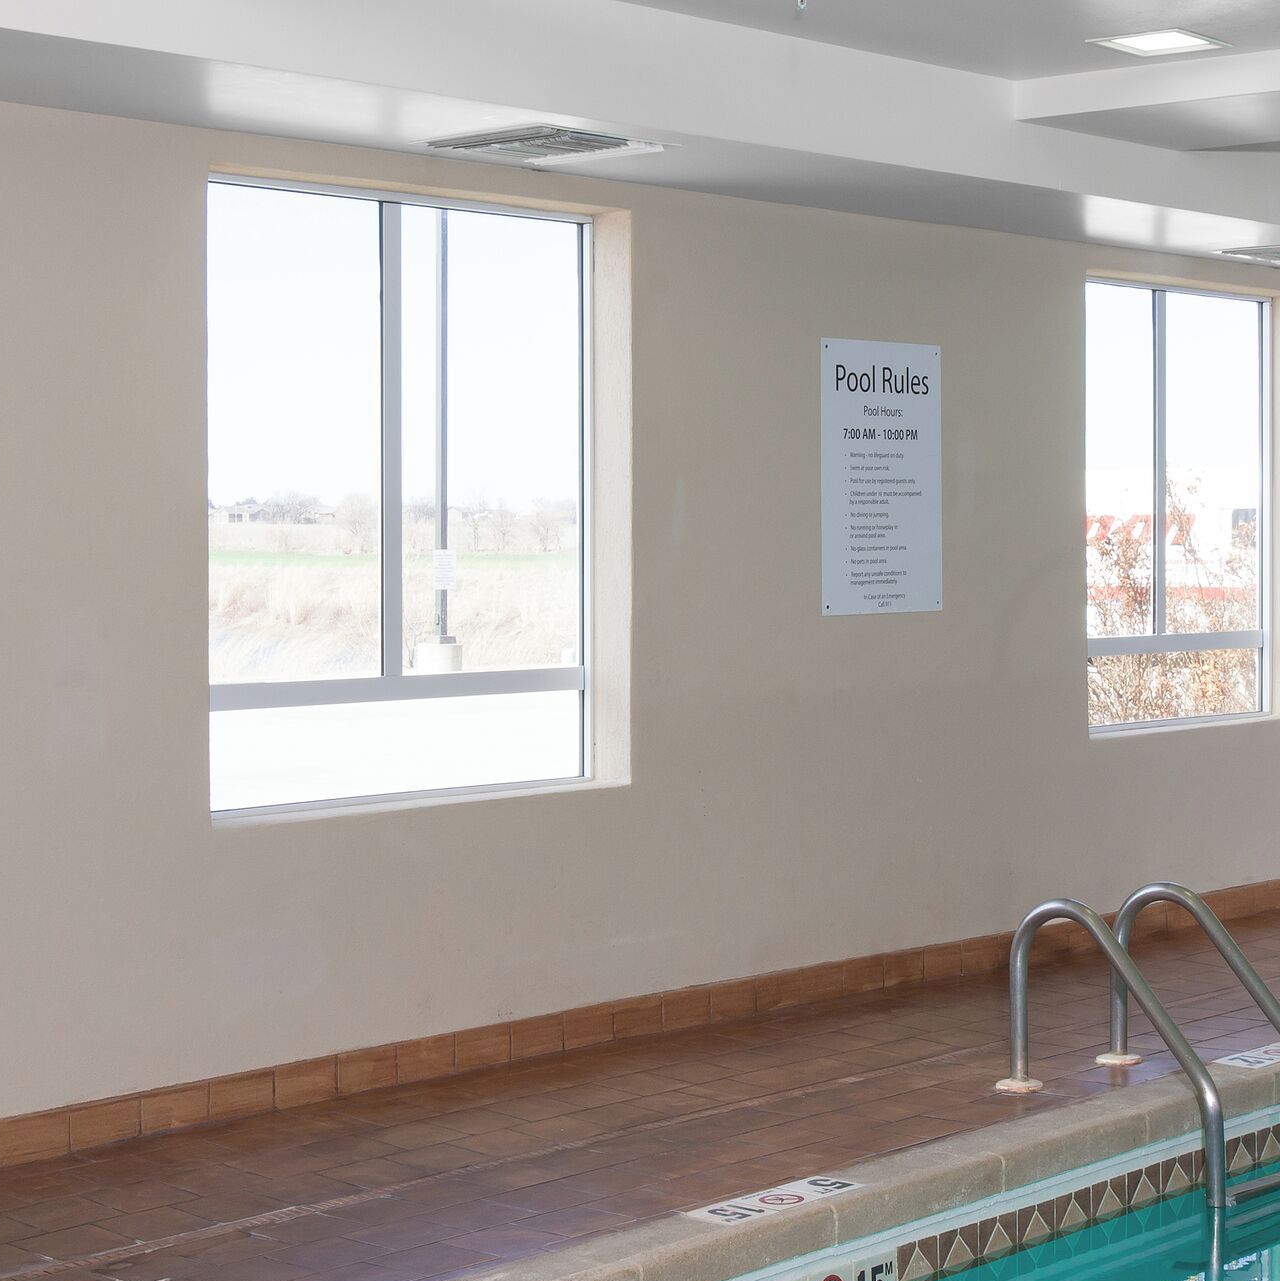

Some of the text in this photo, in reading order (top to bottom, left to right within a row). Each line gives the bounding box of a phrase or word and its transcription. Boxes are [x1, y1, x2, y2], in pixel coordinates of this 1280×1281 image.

[836, 364, 929, 395] Pool Rules
[863, 404, 903, 417] Pool Hours:
[843, 428, 860, 440] 7:00
[862, 428, 876, 439] AM
[882, 429, 904, 440] 10:00
[905, 429, 917, 440] PM
[884, 1260, 893, 1277] M
